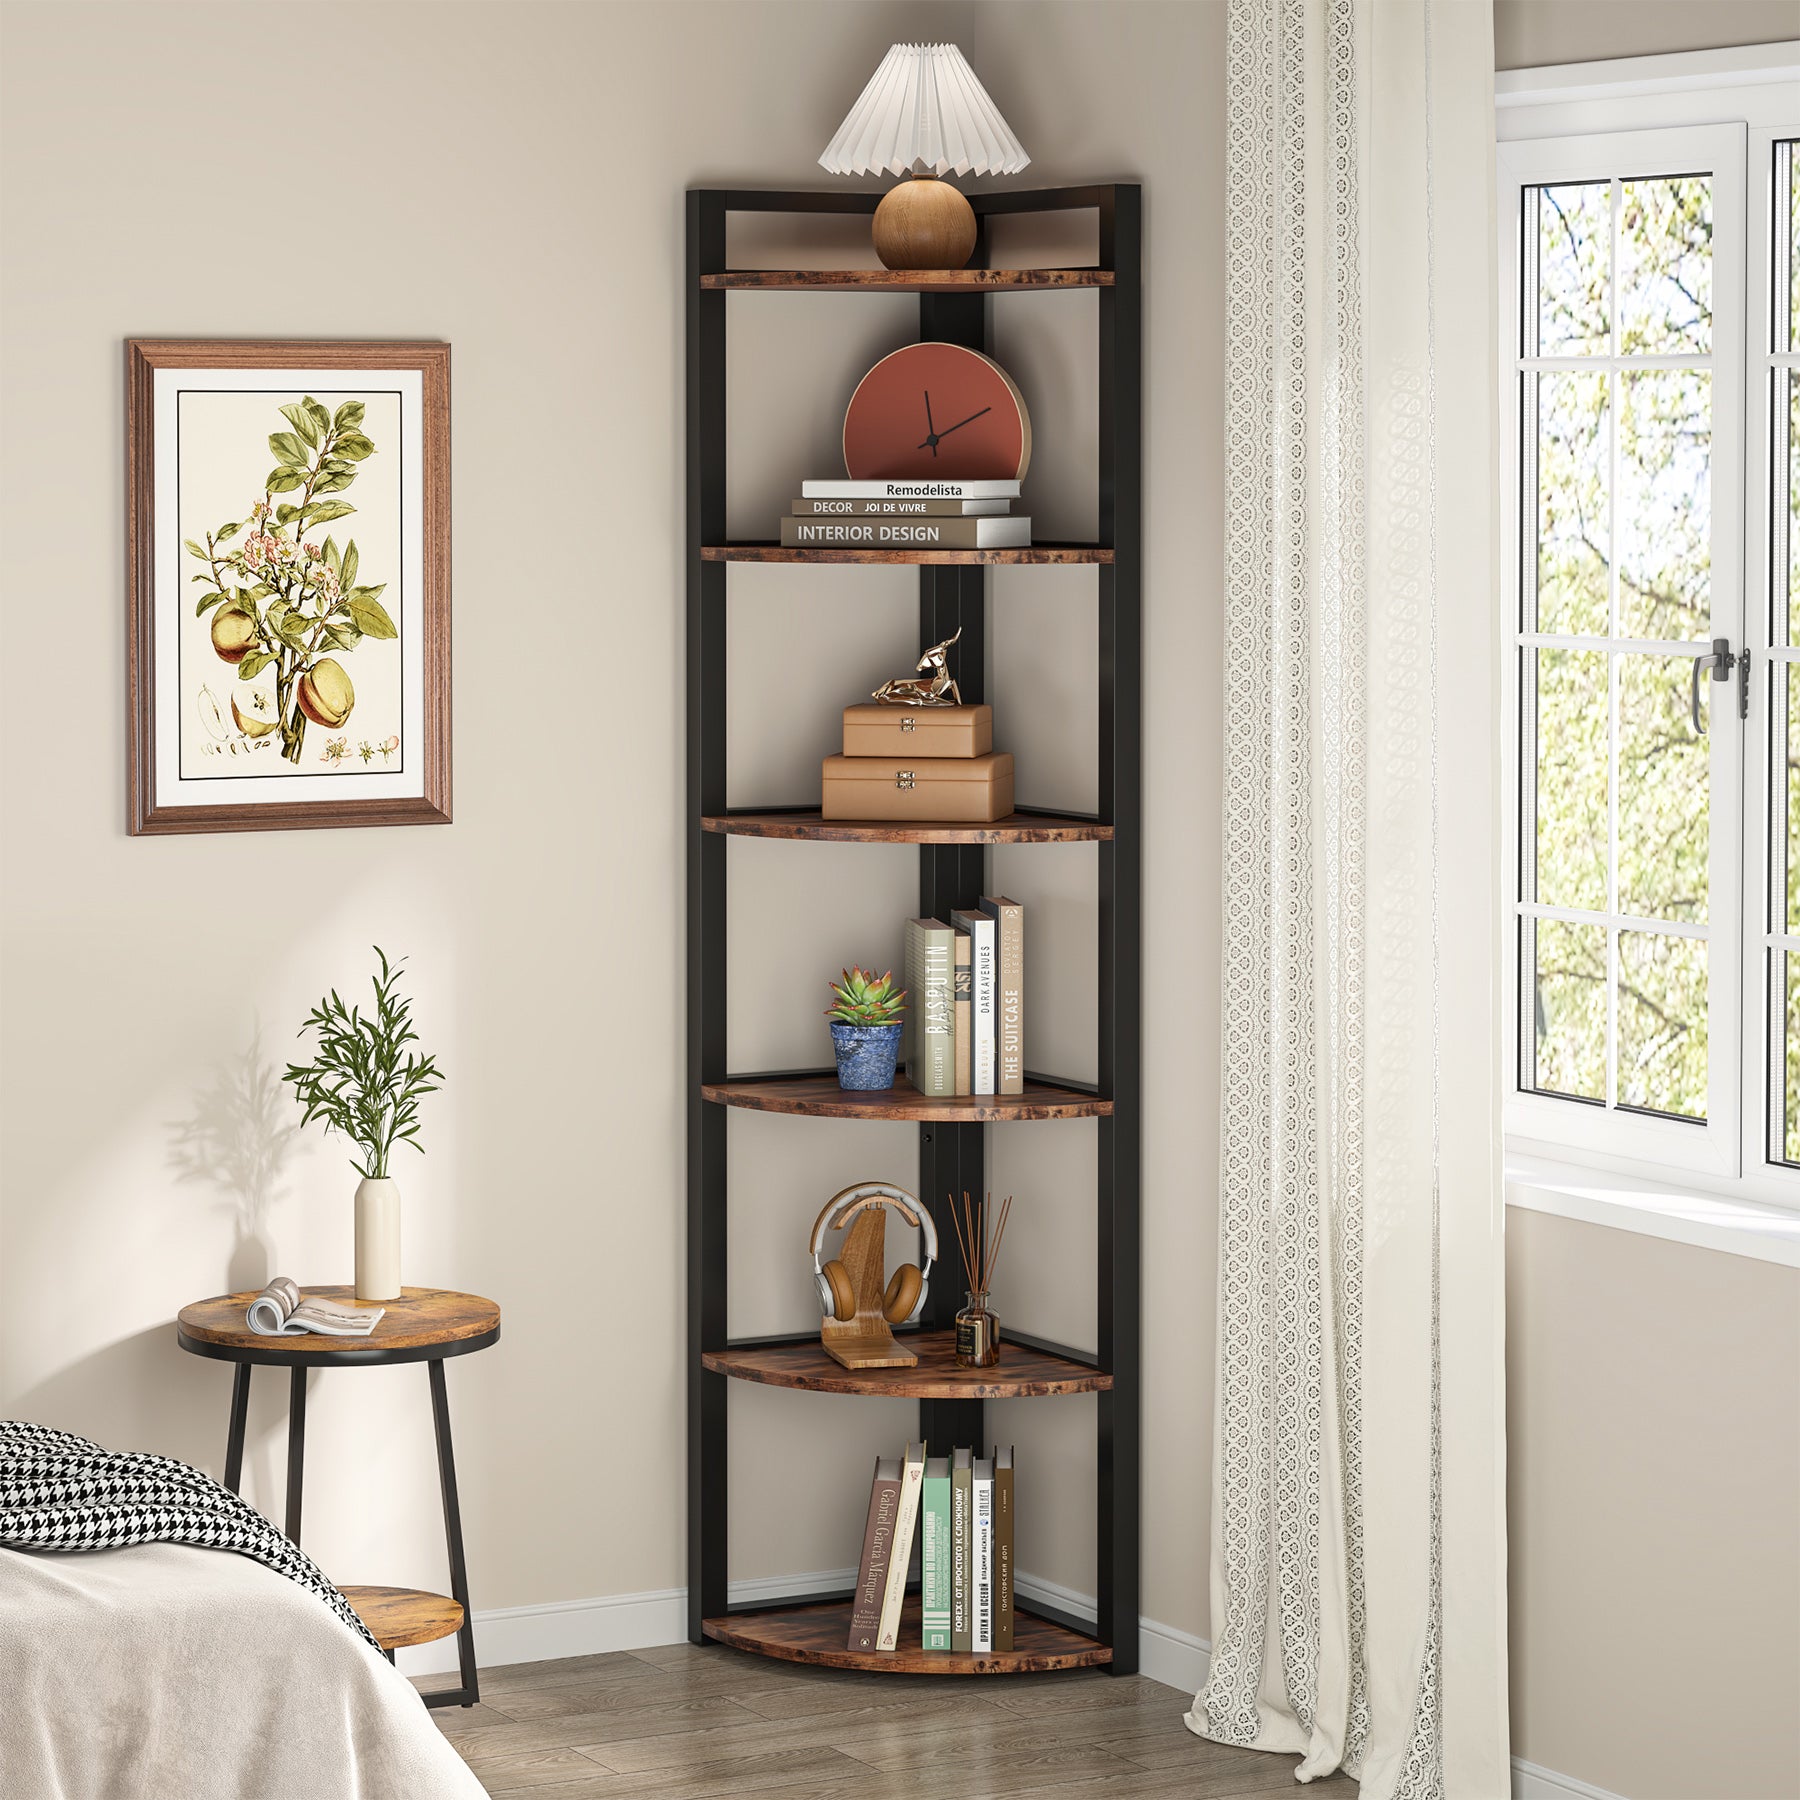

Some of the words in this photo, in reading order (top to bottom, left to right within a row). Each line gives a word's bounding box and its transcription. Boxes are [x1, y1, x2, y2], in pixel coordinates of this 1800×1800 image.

[886, 484, 962, 496] Remodelista
[813, 502, 853, 513] DECOR
[864, 503, 880, 513] JOI
[883, 503, 896, 513] DE
[898, 503, 927, 513] VIVRE
[797, 525, 874, 541] INTERIOR
[879, 526, 940, 542] DESIGN
[981, 945, 990, 987] AVENUES
[925, 945, 948, 1034] RASPUTIN
[981, 990, 990, 1014] DARK
[1005, 989, 1019, 1052] SUITCASE
[981, 1039, 989, 1067] BUNIN
[981, 1070, 989, 1090] IVAN
[1005, 1057, 1019, 1081] THE
[877, 1489, 896, 1525] Gabriel
[955, 1487, 963, 1536] СЛОЖНОМУ
[871, 1527, 890, 1559] García
[955, 1546, 963, 1587] ПРОСТОГО
[862, 1562, 885, 1604] Márquez
[955, 1588, 963, 1599] ОТ
[955, 1602, 963, 1633] FOREX:
[980, 1608, 989, 1617] НА
